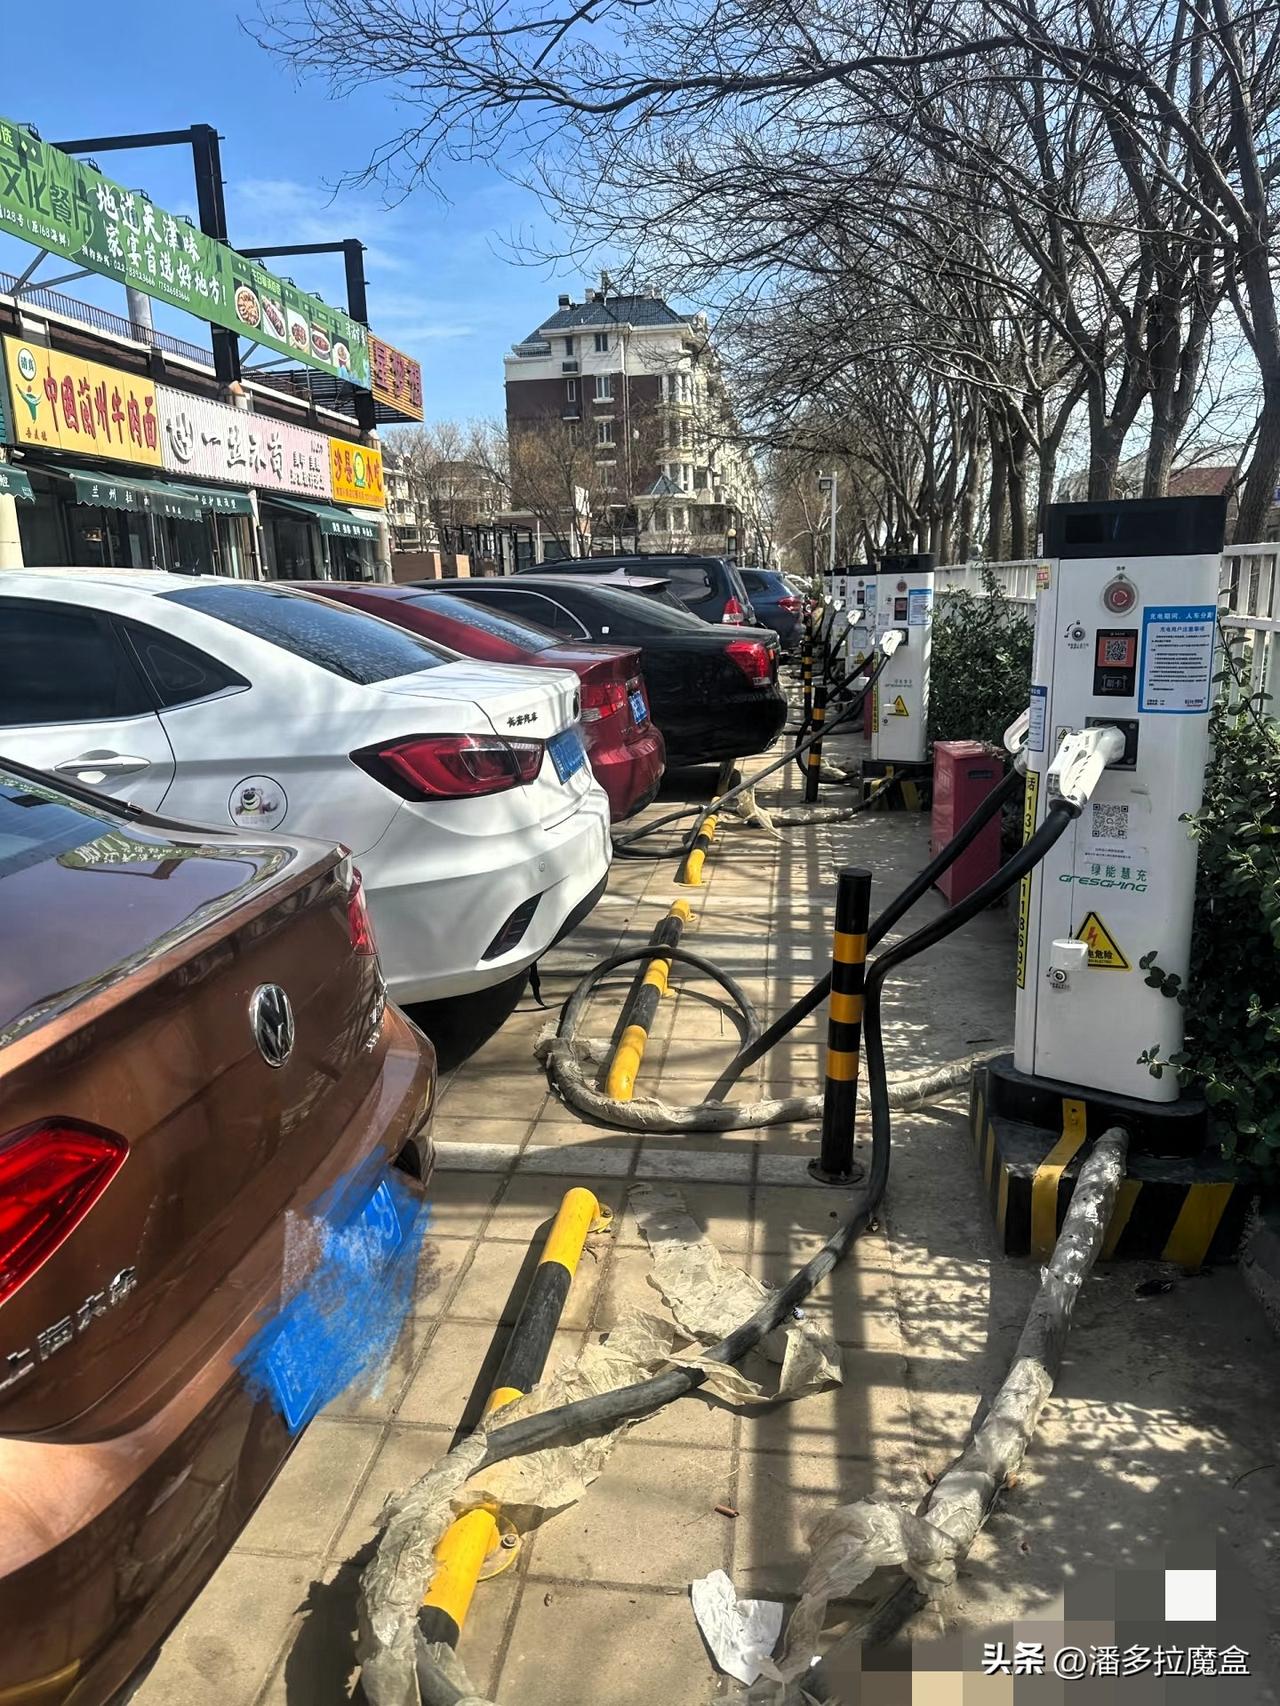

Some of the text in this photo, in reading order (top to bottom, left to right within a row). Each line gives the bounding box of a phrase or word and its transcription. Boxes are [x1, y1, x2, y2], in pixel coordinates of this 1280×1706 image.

[96, 182, 201, 264] 地道天津味
[20, 356, 34, 372] 清真
[334, 448, 382, 492] 沙县小吃
[1091, 863, 1148, 882] 绿能慧充
[1087, 949, 1113, 960] 电危险
